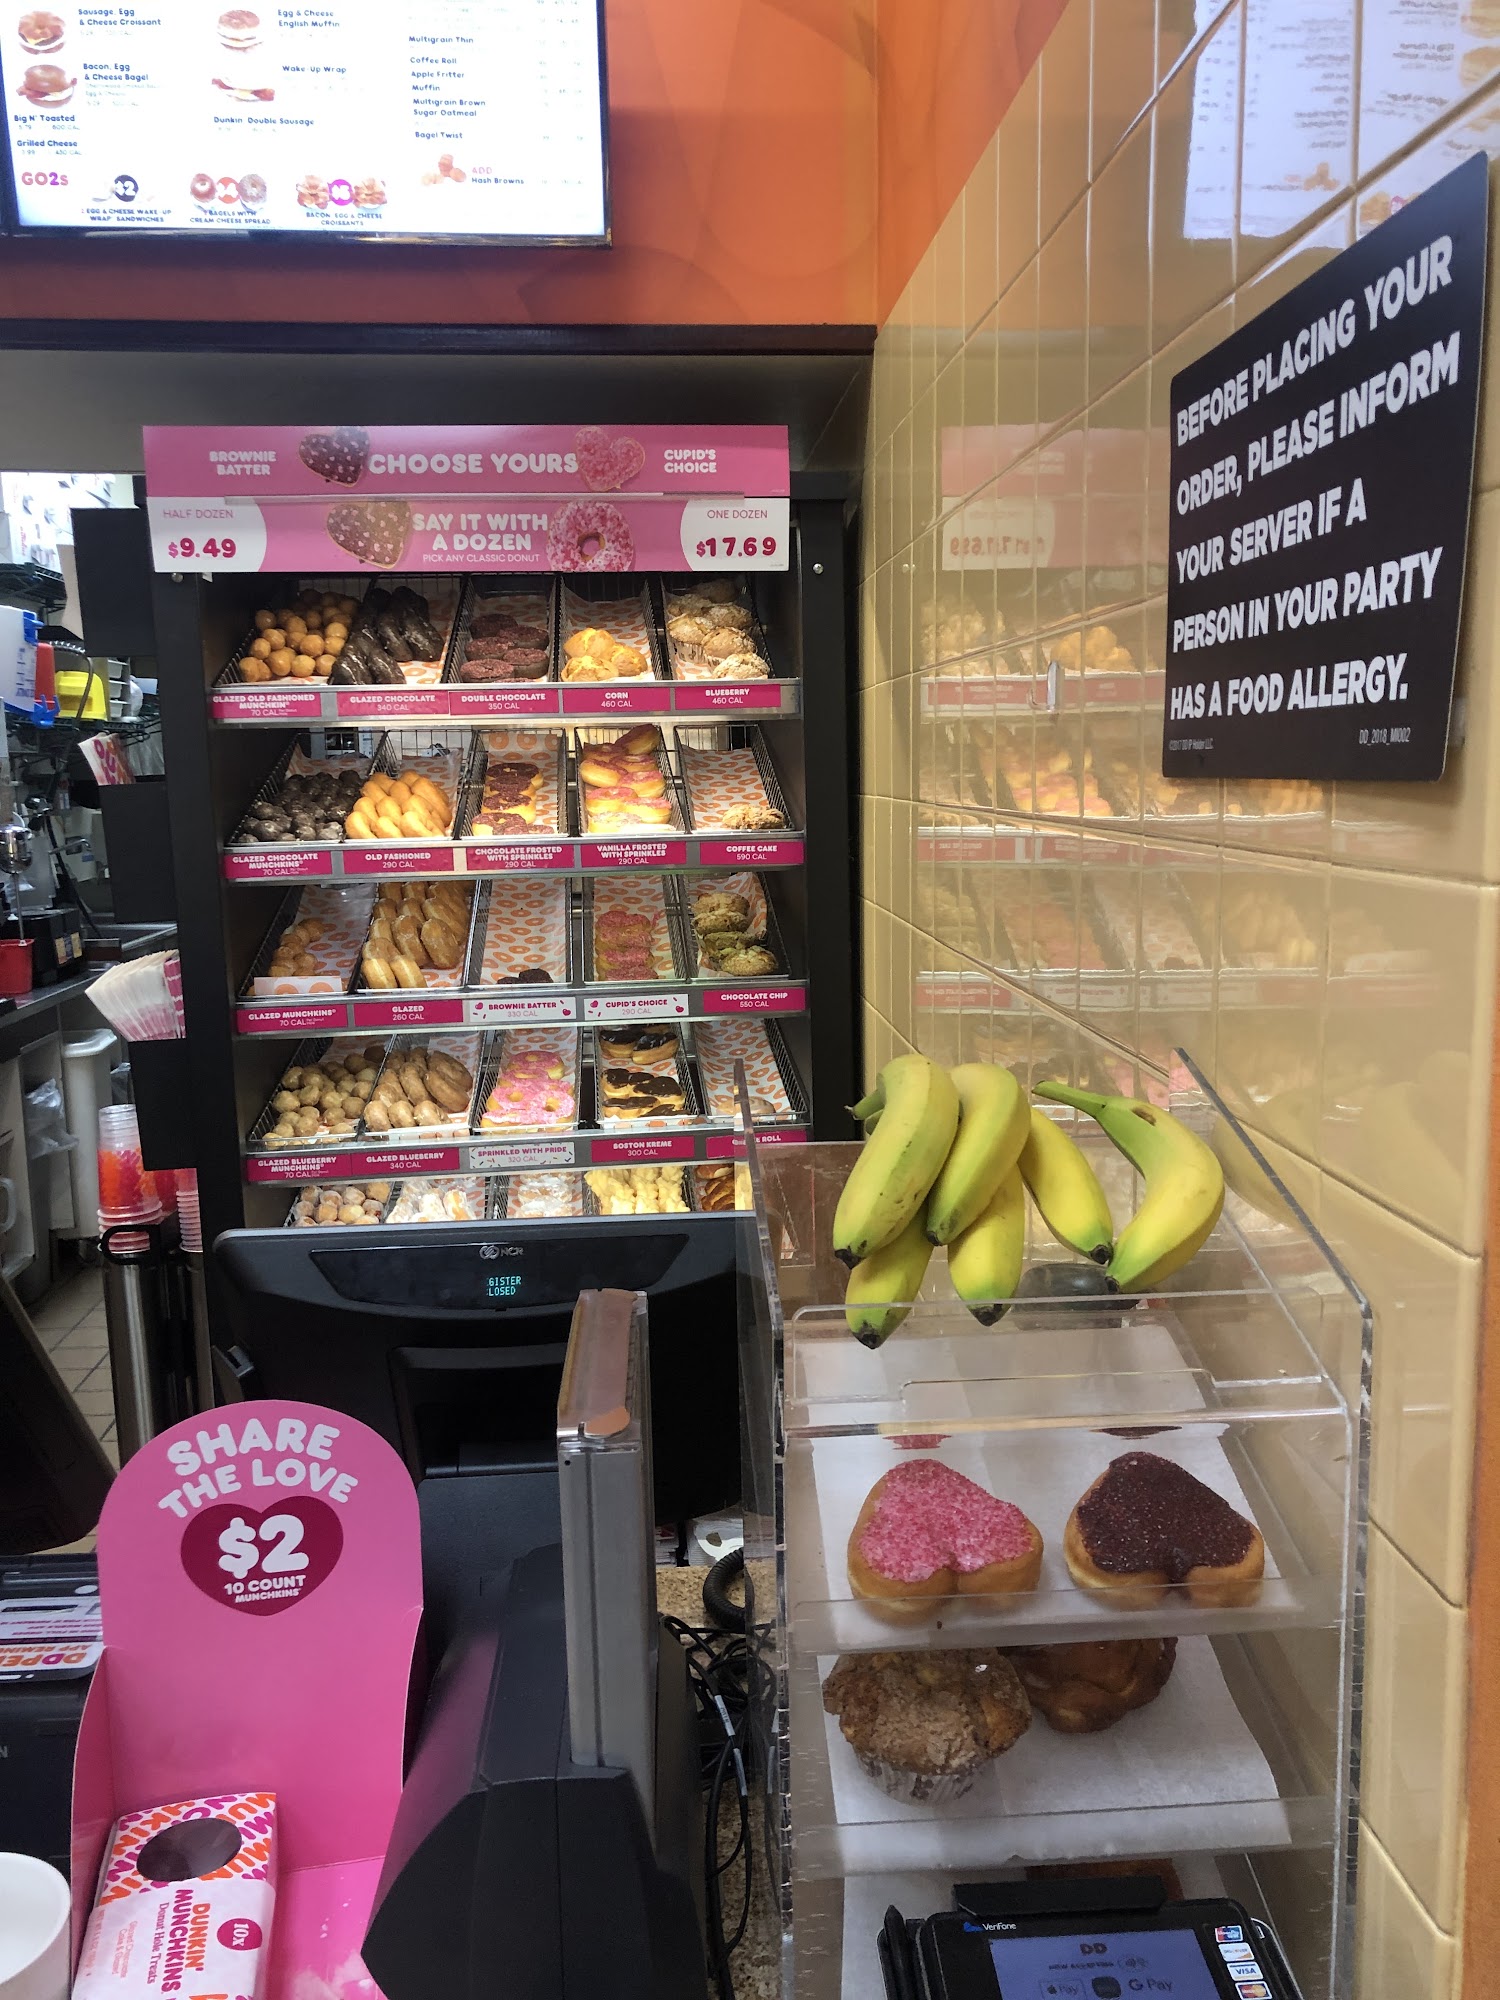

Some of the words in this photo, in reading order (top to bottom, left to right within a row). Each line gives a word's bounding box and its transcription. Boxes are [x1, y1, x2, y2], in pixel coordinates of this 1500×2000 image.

[119, 8, 135, 17] Egg
[278, 9, 294, 18] Egg
[87, 18, 118, 26] Cheese
[120, 18, 162, 26] Croissant
[278, 20, 308, 28] English
[311, 20, 340, 28] Muffin
[408, 36, 453, 44] Multigrain
[456, 36, 474, 44] Thin
[114, 63, 130, 72] Egg
[323, 66, 346, 74] Wrap
[125, 74, 149, 82] Bagel
[413, 98, 457, 107] Multigrain
[14, 114, 27, 123] Big
[40, 114, 75, 122] Toasted
[414, 109, 438, 118] Sugar
[279, 118, 315, 126] Sausage
[415, 132, 438, 140] Bagel
[472, 166, 493, 174] ADD
[1177, 368, 1249, 447] BEFORE
[1252, 298, 1356, 403] PLACING
[1364, 234, 1453, 332] YOUR
[1177, 454, 1242, 516] ORDER,
[1248, 399, 1335, 482] PLEASE
[1340, 330, 1461, 438] INFORM
[208, 450, 277, 463] BROWNIE
[663, 448, 717, 461] CUPID'S
[368, 453, 484, 475] CHOOSE
[490, 453, 579, 474] YOURS
[663, 462, 718, 474] CHOICE
[216, 464, 271, 476] BATTER
[162, 508, 192, 520] HALF
[195, 508, 234, 520] DOZEN
[706, 509, 730, 520] ONE
[732, 509, 768, 520] DOZEN
[412, 513, 454, 532] SAY
[460, 513, 482, 532] IT
[486, 512, 548, 532] WITH
[1176, 535, 1225, 584] YOUR
[1229, 498, 1313, 566] SERVER
[1317, 486, 1342, 536] IF
[1345, 477, 1367, 526] A
[168, 537, 237, 559] $9.49
[432, 533, 449, 552] A
[452, 533, 532, 552] DOZEN
[696, 536, 777, 558] $17.69
[422, 553, 444, 564] PICK
[446, 553, 466, 564] ANY
[467, 553, 506, 563] CLASSIC
[507, 553, 540, 562] DONUT
[1173, 602, 1246, 654] PERSON
[1248, 596, 1270, 638] IN
[1274, 577, 1340, 632] YOUR
[1342, 546, 1444, 618] PARTY
[1170, 685, 1206, 721] HAS
[1208, 681, 1222, 718] A
[1227, 672, 1284, 716] FOOD
[1286, 652, 1408, 711] ALLERGY.
[248, 694, 266, 702] OLD
[267, 694, 315, 702] FASHIONED
[461, 695, 490, 703] DOUBLE
[491, 693, 546, 702] CHOCOLATE
[705, 688, 750, 697] BLUEBERRY
[350, 696, 383, 704] GLAZED
[384, 695, 436, 703] CHOCOLATE
[601, 700, 616, 708] 460
[617, 700, 633, 708] CAL
[475, 847, 526, 856] CHOCOLATE
[526, 846, 562, 854] FROSTED
[597, 845, 629, 853] VANILLA
[601, 851, 622, 859] WITH
[623, 850, 666, 858] SPRINKLES
[726, 845, 756, 853] COFFEE
[232, 855, 266, 864] GLAZED
[266, 853, 318, 862] CHOCOLATE
[365, 853, 383, 861] OLD
[384, 852, 431, 860] FASHIONED
[510, 853, 553, 861] SPRINKLES
[721, 993, 772, 1001] CHOCOLATE
[392, 1005, 424, 1013] GLAZED
[488, 1002, 526, 1010] BROWNIE
[526, 1001, 557, 1009] BATTER
[605, 1000, 638, 1008] CUPID'S
[640, 999, 668, 1007] CHOICE
[248, 1012, 281, 1021] GLAZED
[613, 1142, 640, 1150] BOSTON
[641, 1140, 672, 1148] KREME
[478, 1147, 520, 1157] SPRINKLED
[521, 1146, 539, 1154] WITH
[540, 1146, 567, 1154] PRIDE
[258, 1158, 290, 1167] GLAZED
[291, 1156, 337, 1165] BLUEBERRY
[366, 1155, 398, 1163] GLAZED
[399, 1152, 444, 1161] BLUEBERRY
[500, 1246, 524, 1257] NCR
[486, 1276, 522, 1286] GISTER
[486, 1286, 516, 1296] LOSED
[166, 1418, 341, 1476] SHARE
[158, 1464, 242, 1519] THE
[251, 1458, 359, 1504] LOVE
[218, 1514, 310, 1580] $2
[224, 1582, 245, 1596] 10
[247, 1574, 306, 1593] COUNT
[154, 1902, 170, 1931] Donut
[982, 1922, 1017, 1932] VeriFone
[184, 1902, 211, 1972] DUNKIN'
[232, 1922, 250, 1946] 10x
[151, 1930, 164, 1952] Hole
[160, 1889, 194, 1992] MUNCHKINS
[1080, 1942, 1108, 1956] DD
[146, 1952, 162, 1984] Treats
[1058, 1984, 1078, 1996] Pay
[1146, 1979, 1173, 1993] Pay
